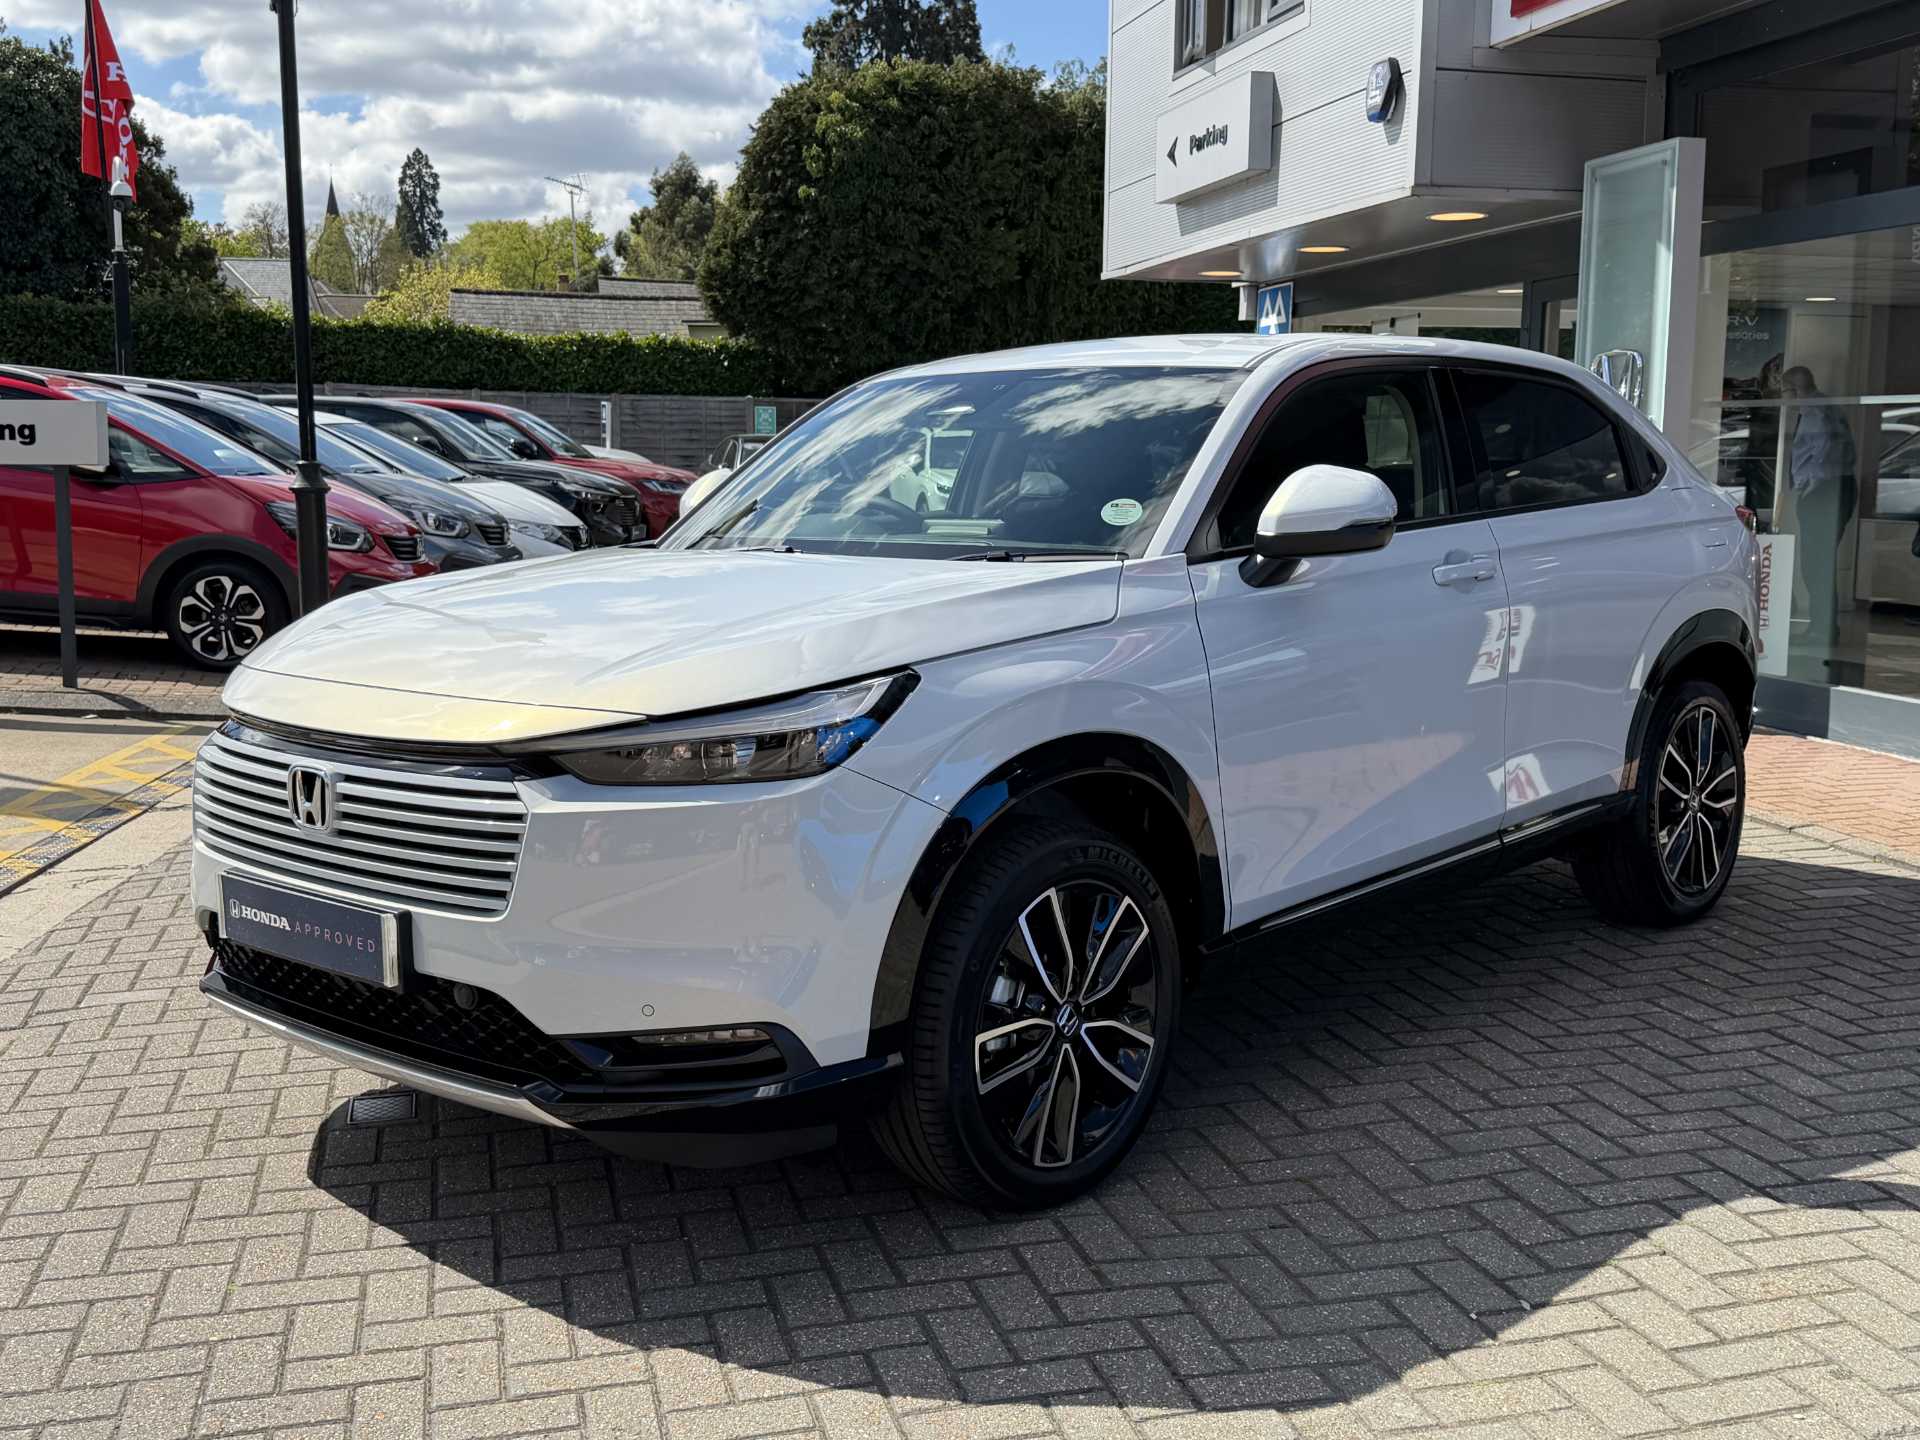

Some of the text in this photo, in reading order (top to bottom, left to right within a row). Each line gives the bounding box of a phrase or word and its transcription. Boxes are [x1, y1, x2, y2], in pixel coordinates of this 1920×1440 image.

[1189, 124, 1228, 156] Parking
[0, 423, 36, 446] ng
[1760, 543, 1772, 610] HONDA
[1087, 846, 1160, 900] MICHELIN
[241, 905, 376, 953] HONDA APPROVED
